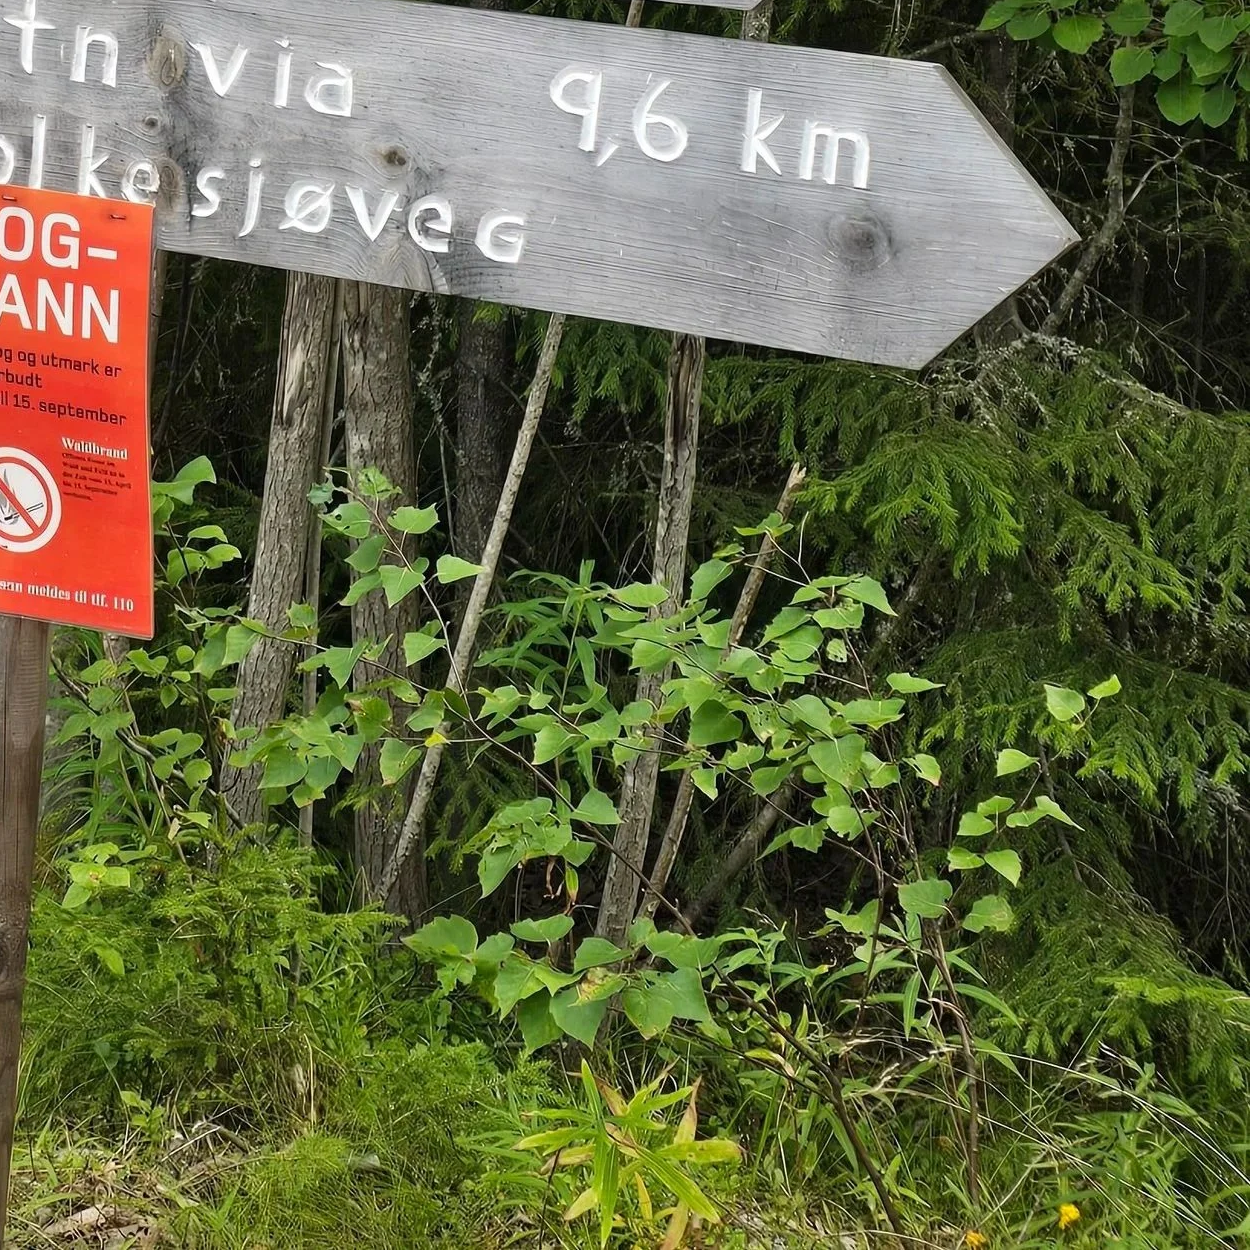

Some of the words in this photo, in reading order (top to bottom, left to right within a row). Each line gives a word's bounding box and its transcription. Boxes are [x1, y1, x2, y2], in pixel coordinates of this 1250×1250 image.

[190, 37, 354, 118] via
[550, 64, 689, 168] 9,6
[740, 87, 872, 190] km
[17, 350, 37, 367] og
[41, 352, 100, 375] utmark
[104, 365, 122, 378] er
[13, 394, 35, 411] 15.
[39, 400, 127, 427] september
[61, 436, 128, 461] Waldbrand
[27, 583, 71, 600] meldes
[74, 589, 87, 603] til
[113, 596, 134, 612] 110
